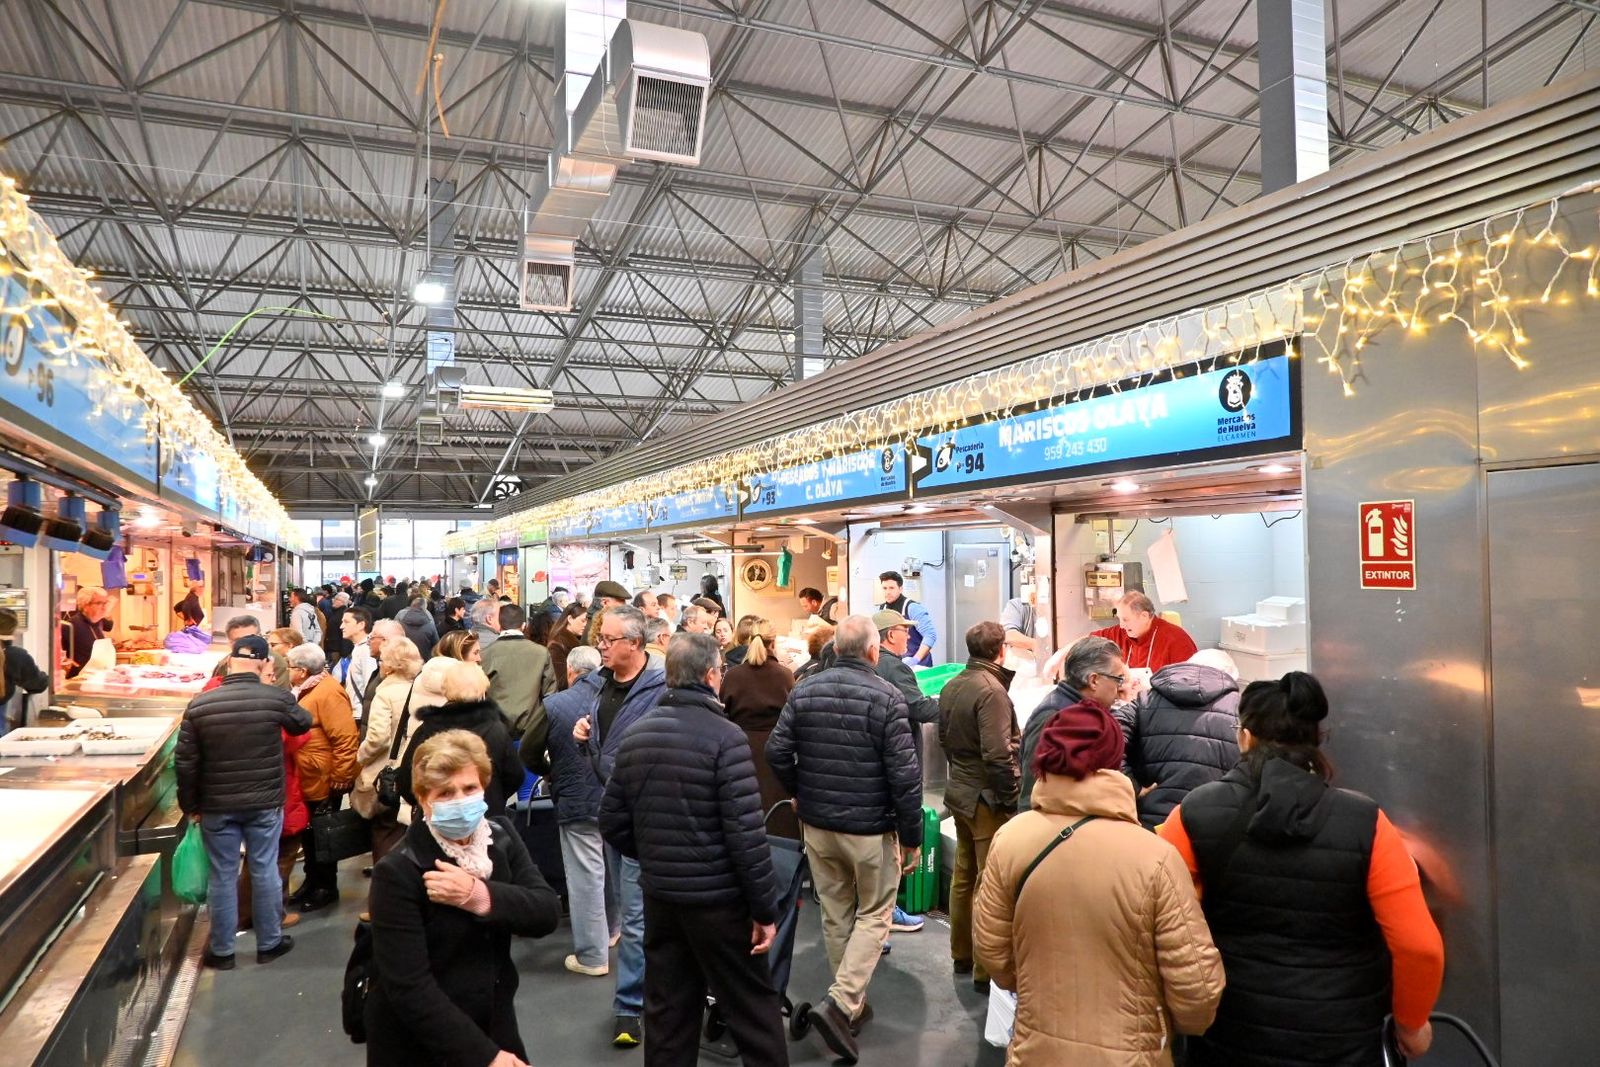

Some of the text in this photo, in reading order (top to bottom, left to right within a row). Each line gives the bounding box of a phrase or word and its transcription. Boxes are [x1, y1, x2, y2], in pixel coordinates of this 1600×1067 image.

[998, 392, 1168, 448] MARISCOS OLAYA
[1217, 422, 1256, 434] de Huelva
[1044, 443, 1063, 461] 959
[815, 480, 843, 498] OLAYA
[1365, 570, 1411, 580] EXTINTOR
